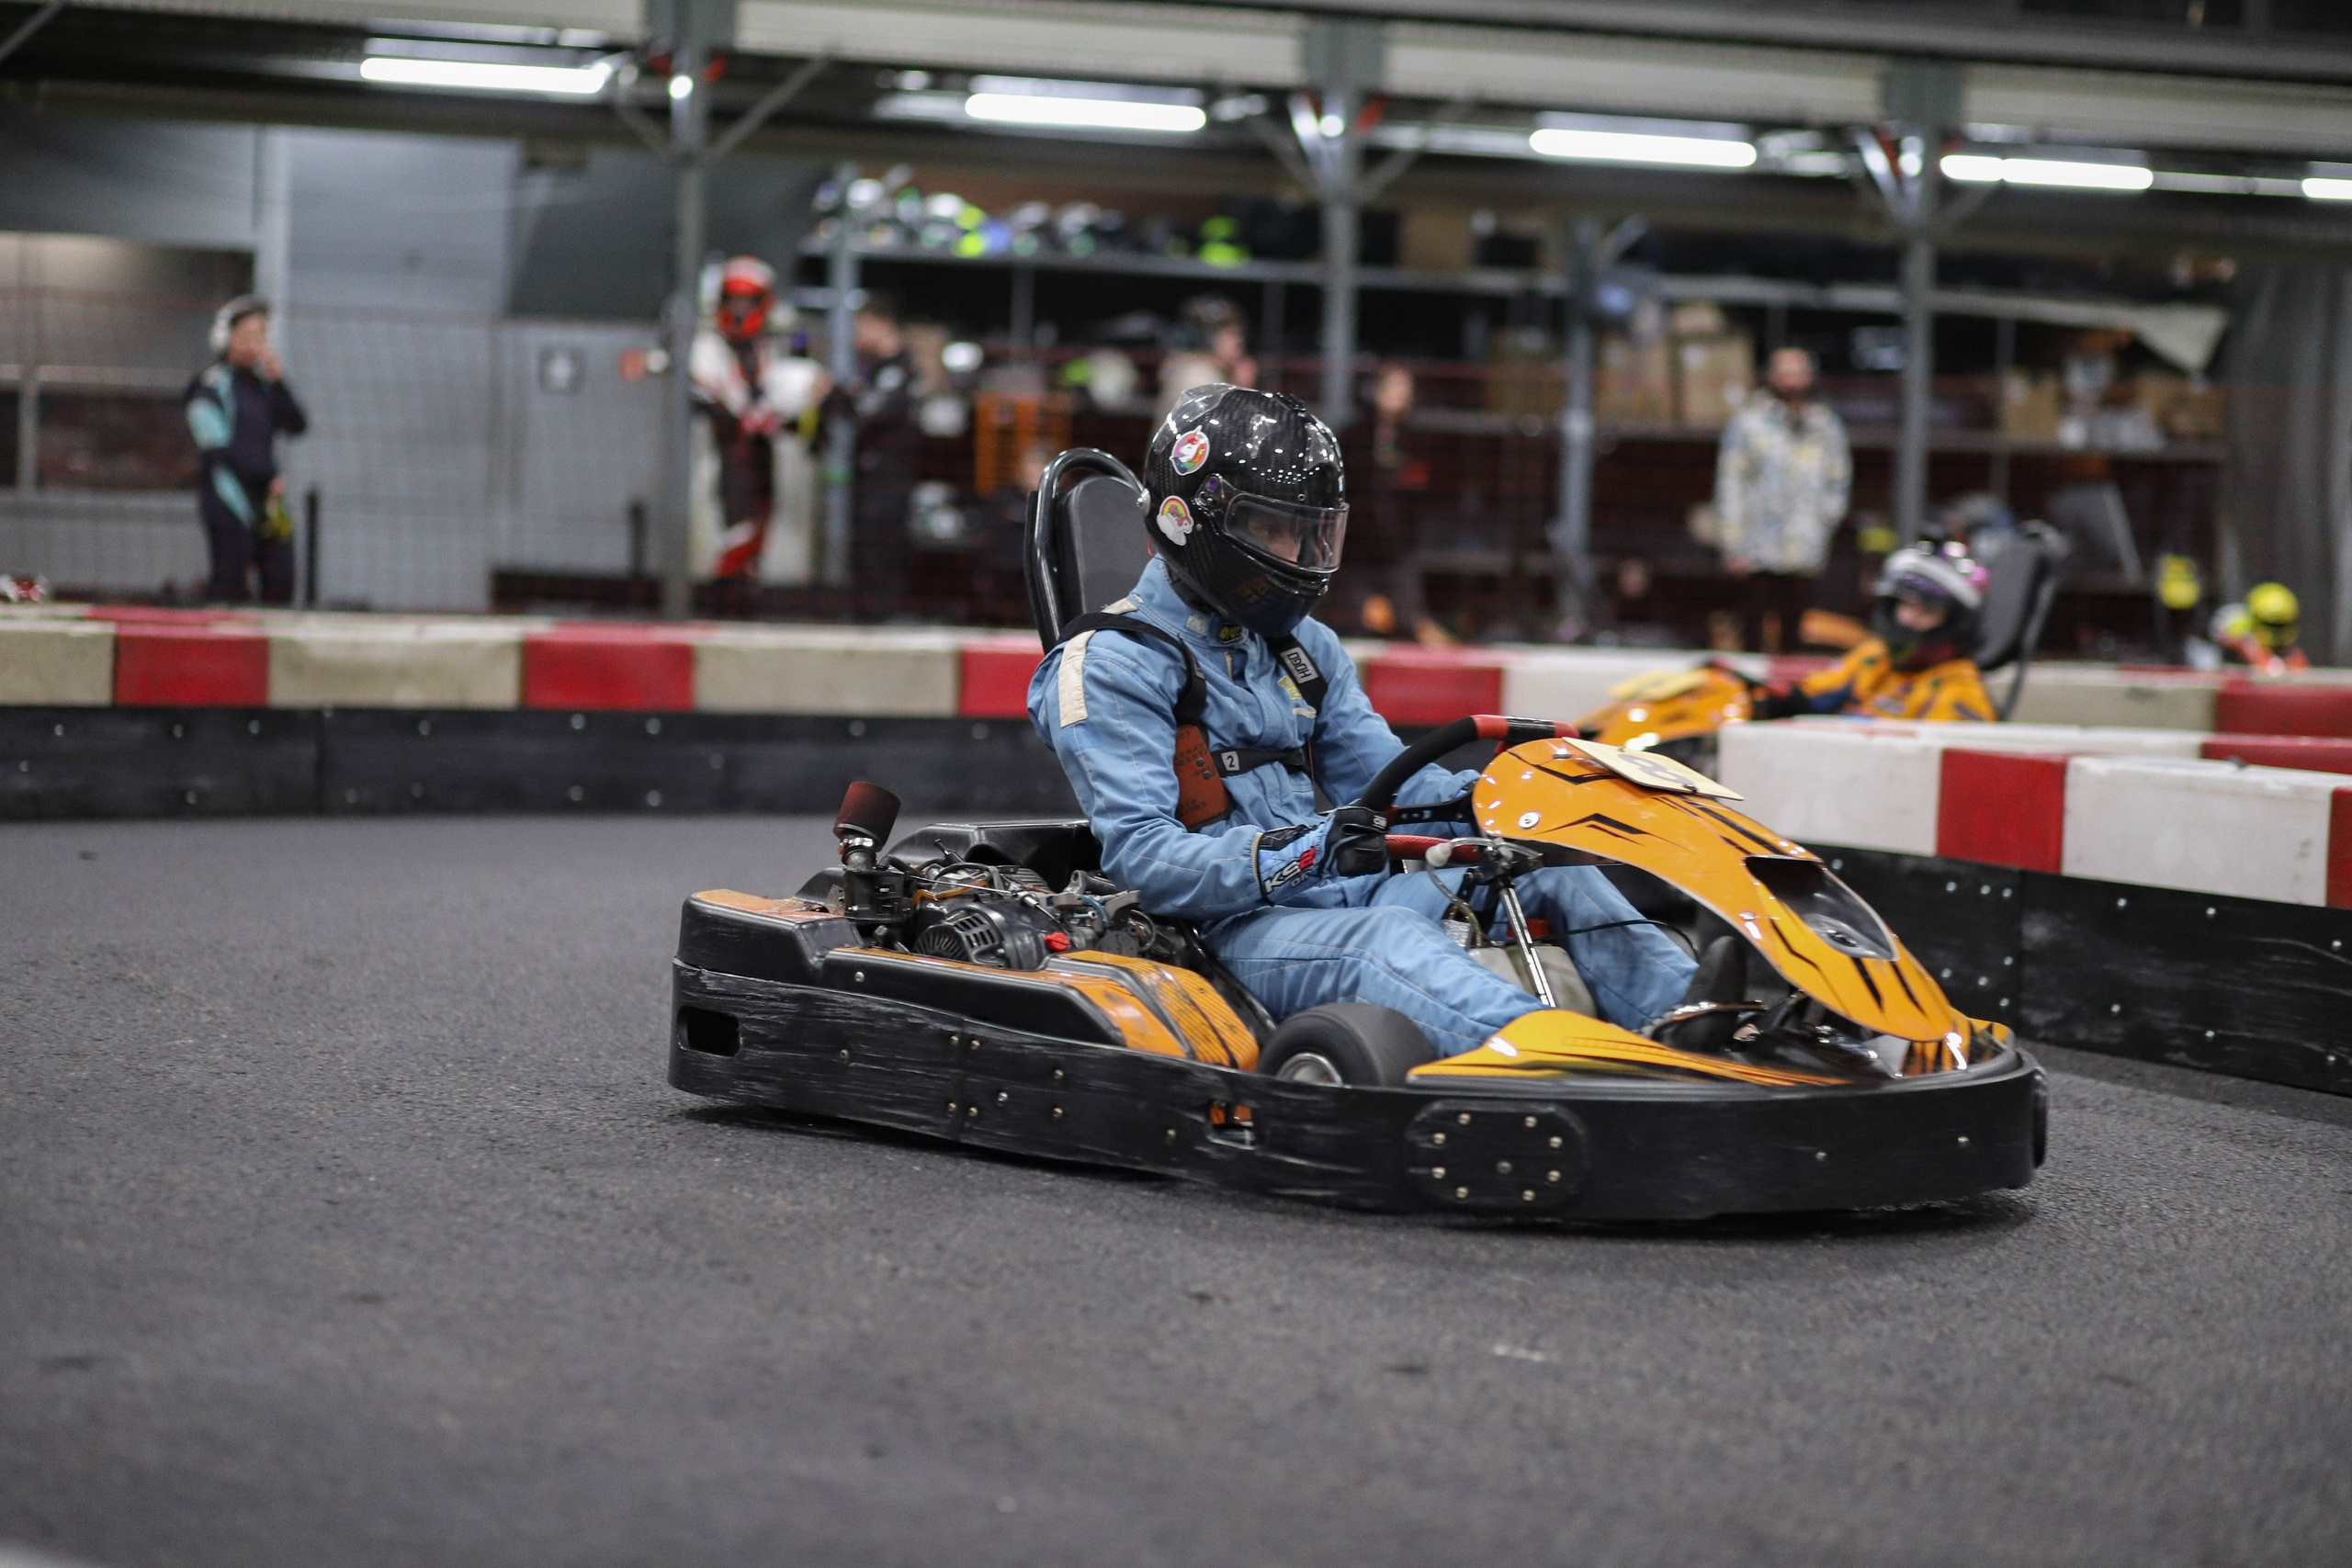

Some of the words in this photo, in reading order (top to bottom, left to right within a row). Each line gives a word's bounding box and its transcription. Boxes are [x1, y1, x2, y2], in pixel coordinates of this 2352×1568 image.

[1287, 651, 1312, 679] HOGO
[1227, 755, 1235, 768] 2
[1617, 753, 1694, 786] 8
